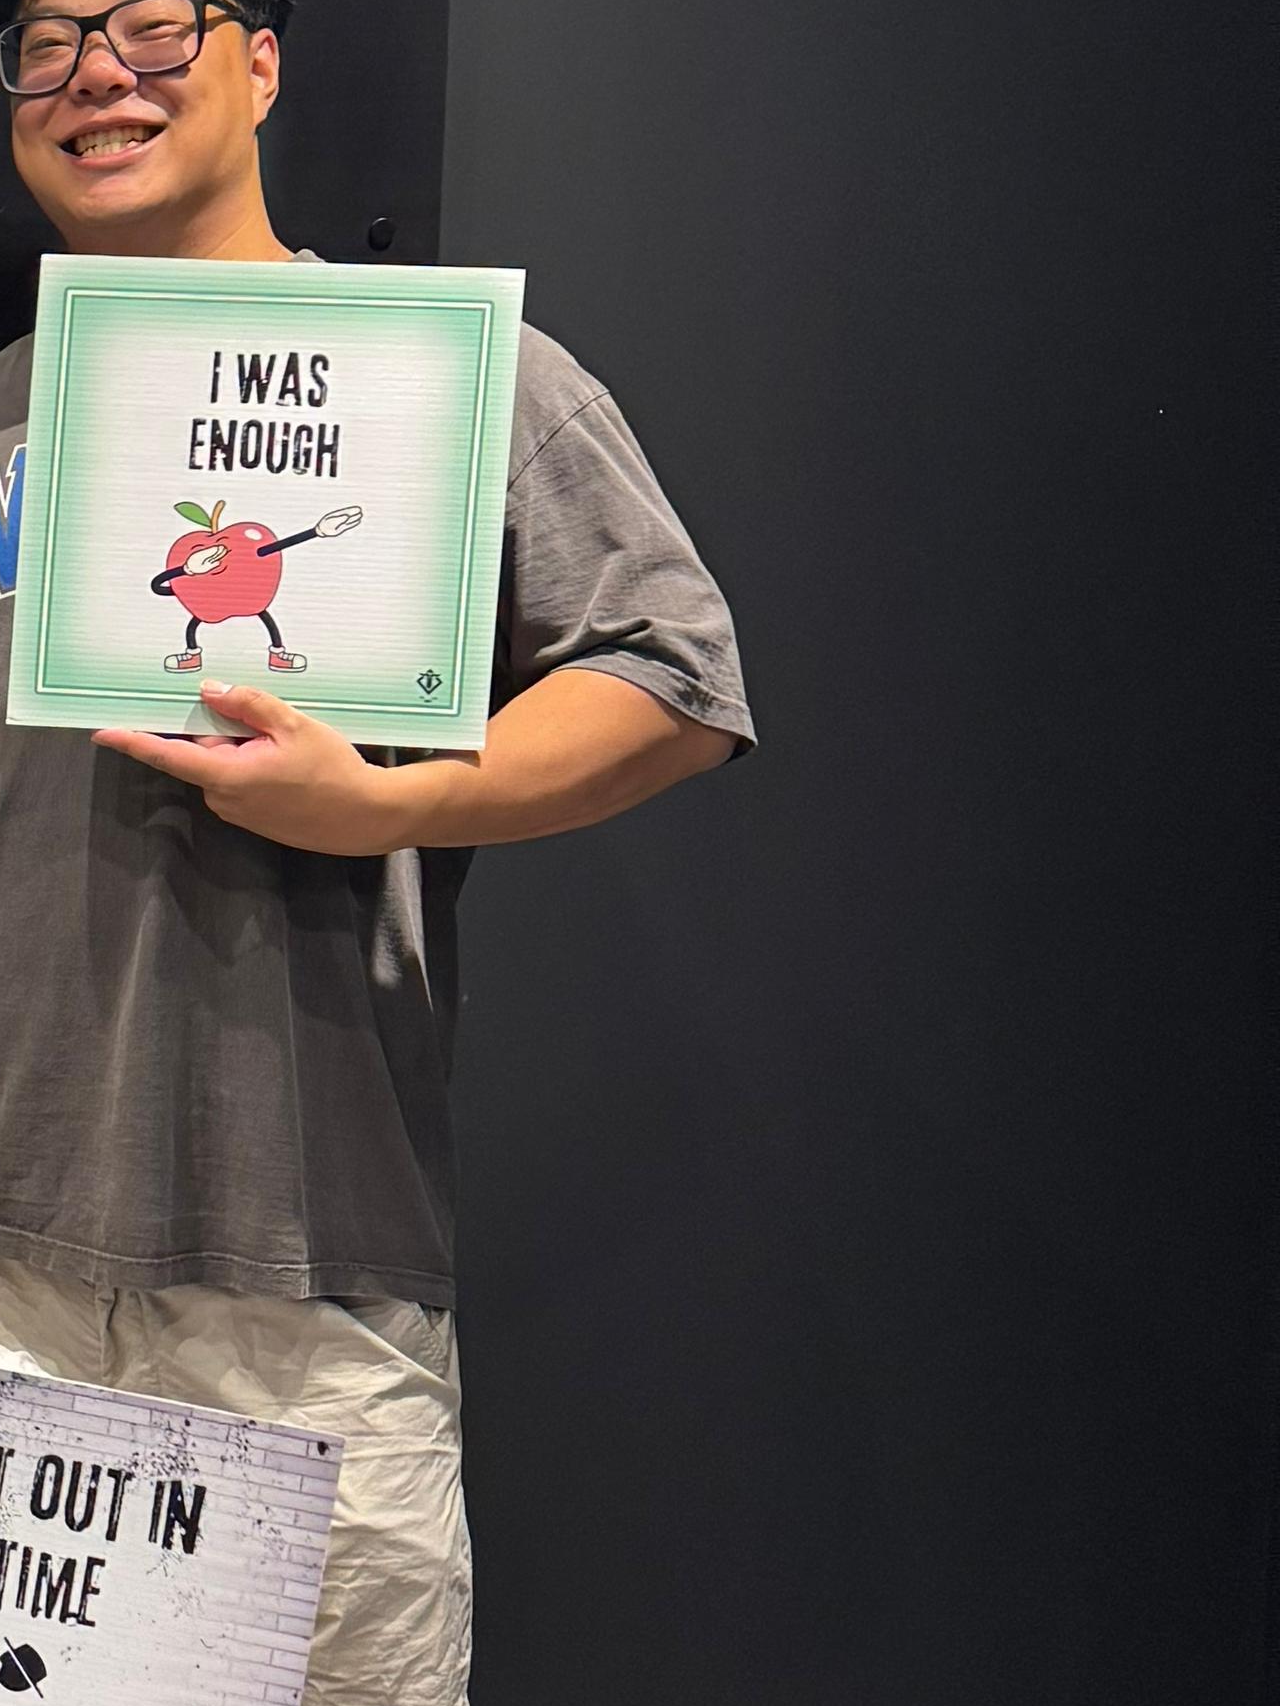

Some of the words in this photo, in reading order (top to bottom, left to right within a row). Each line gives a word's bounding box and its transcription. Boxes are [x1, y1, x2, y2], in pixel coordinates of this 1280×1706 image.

[210, 351, 222, 403] I
[237, 351, 330, 408] WAS
[188, 417, 341, 478] ENOUGH
[30, 1454, 134, 1542] OUT
[148, 1480, 208, 1555] IN
